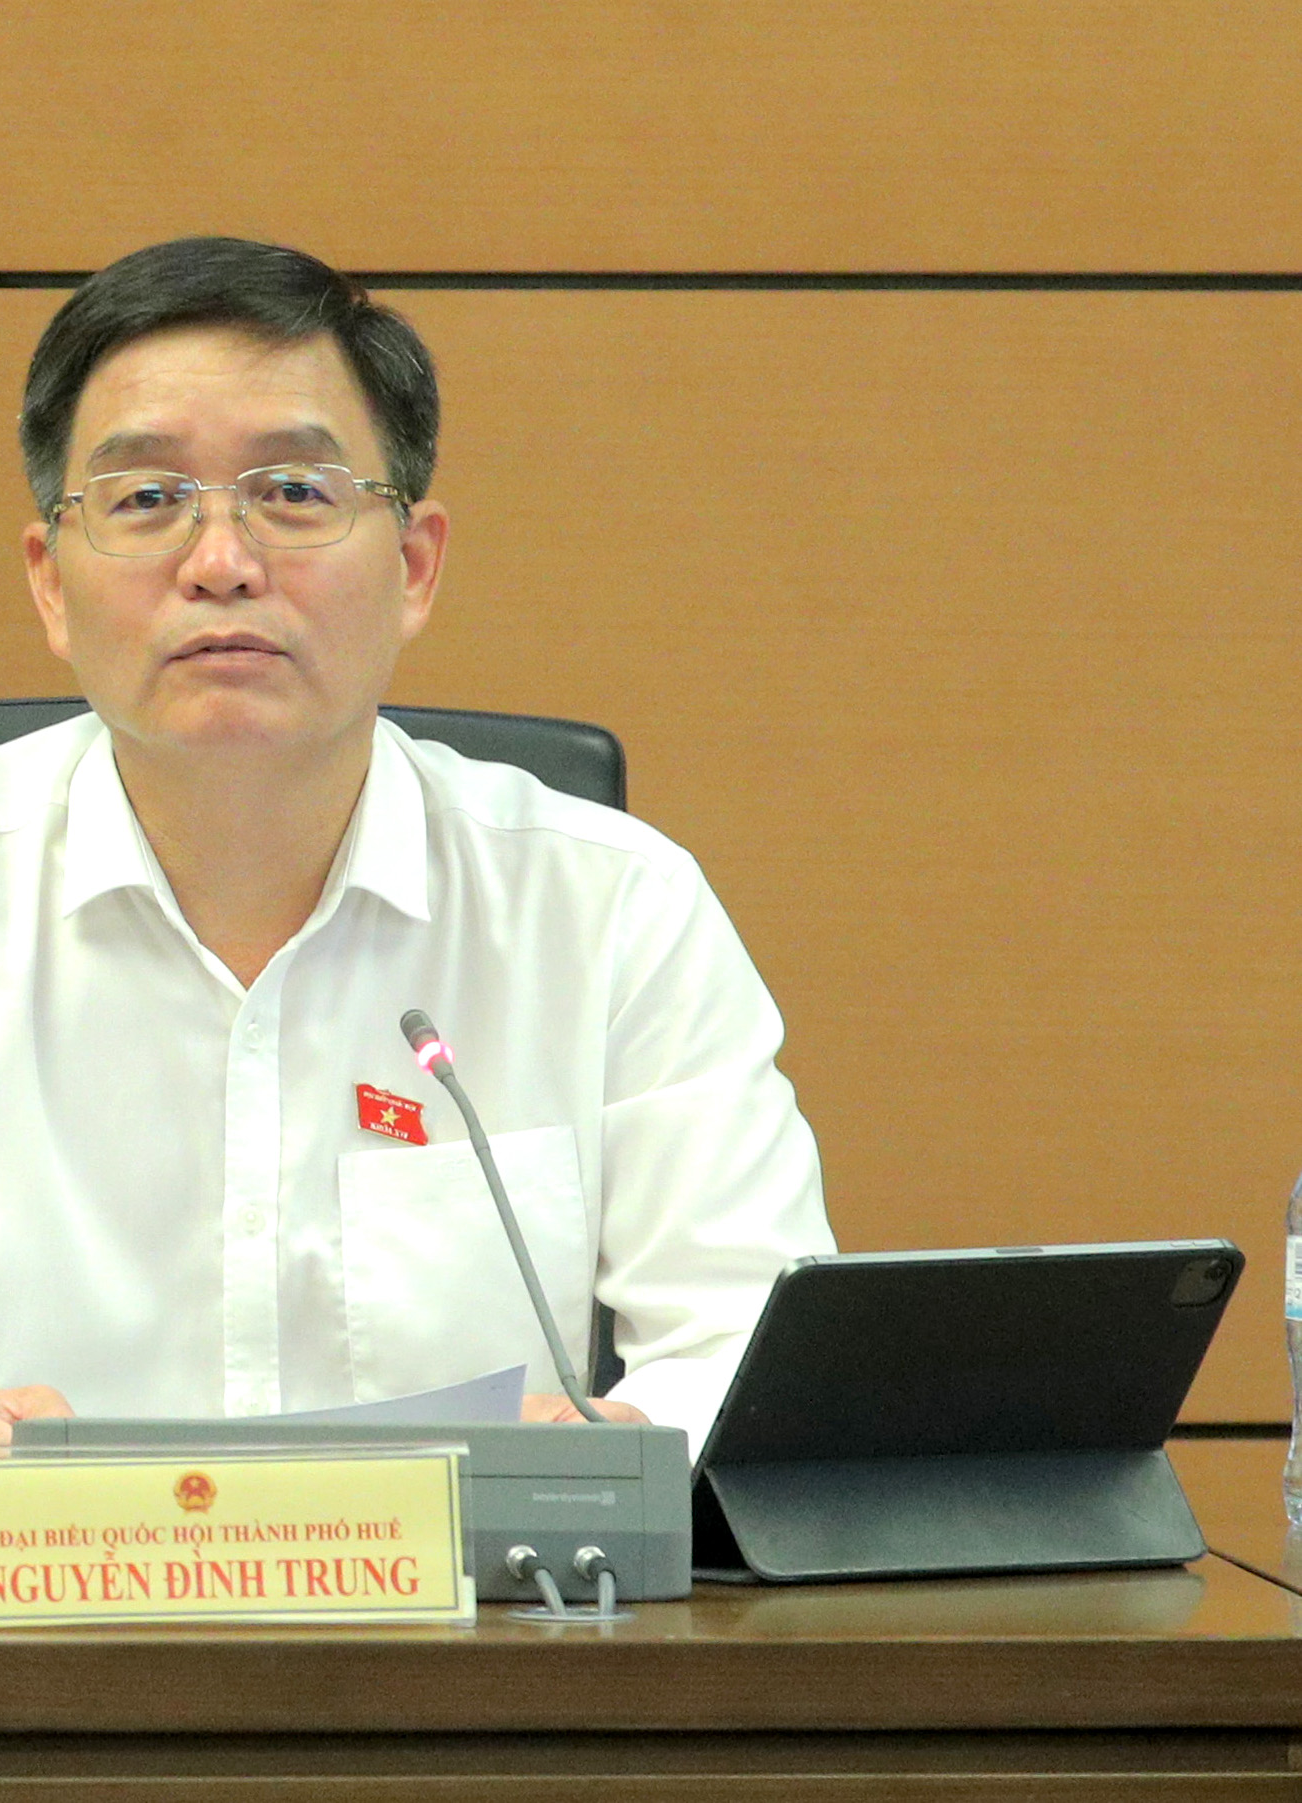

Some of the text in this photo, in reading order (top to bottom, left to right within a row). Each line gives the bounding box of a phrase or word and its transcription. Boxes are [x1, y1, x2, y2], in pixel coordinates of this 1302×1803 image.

[44, 1524, 95, 1547] BIỂU
[101, 1523, 166, 1548] QUỐC
[173, 1525, 213, 1546] HỘI
[219, 1518, 297, 1543] THÀNH
[304, 1518, 351, 1542] PHỐ
[357, 1516, 403, 1541] HUẾ
[163, 1549, 266, 1600] ĐÌNH
[276, 1556, 420, 1598] TRUNG
